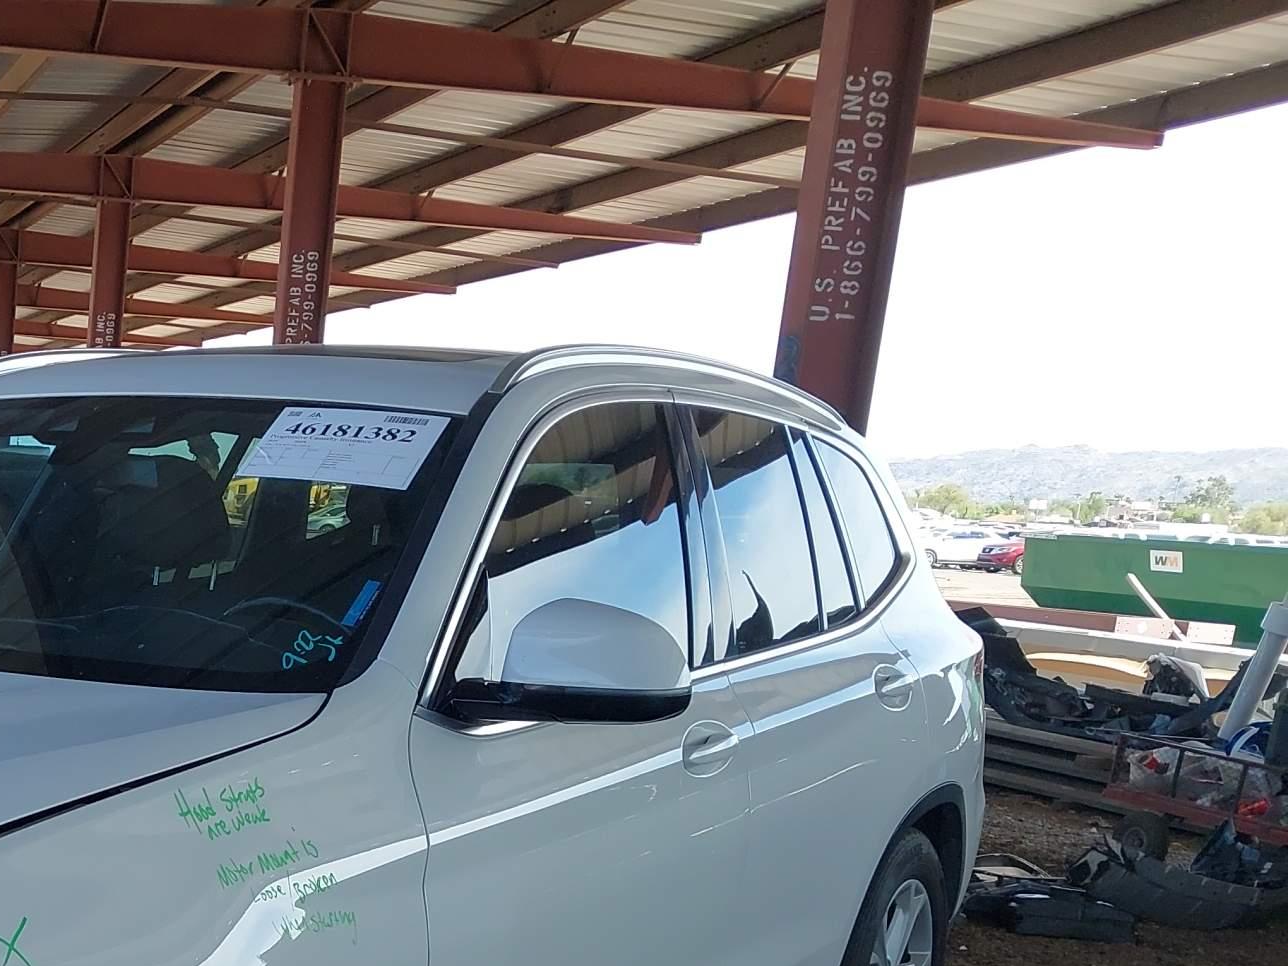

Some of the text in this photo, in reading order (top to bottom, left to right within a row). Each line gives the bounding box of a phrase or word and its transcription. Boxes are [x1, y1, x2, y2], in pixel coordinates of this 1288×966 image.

[821, 138, 856, 250] PREFAB
[841, 66, 868, 121] INC.
[835, 70, 893, 321] 1-866-799-0969
[291, 250, 305, 278] INC.
[285, 421, 417, 443] 46181382
[1154, 555, 1179, 568] WM
